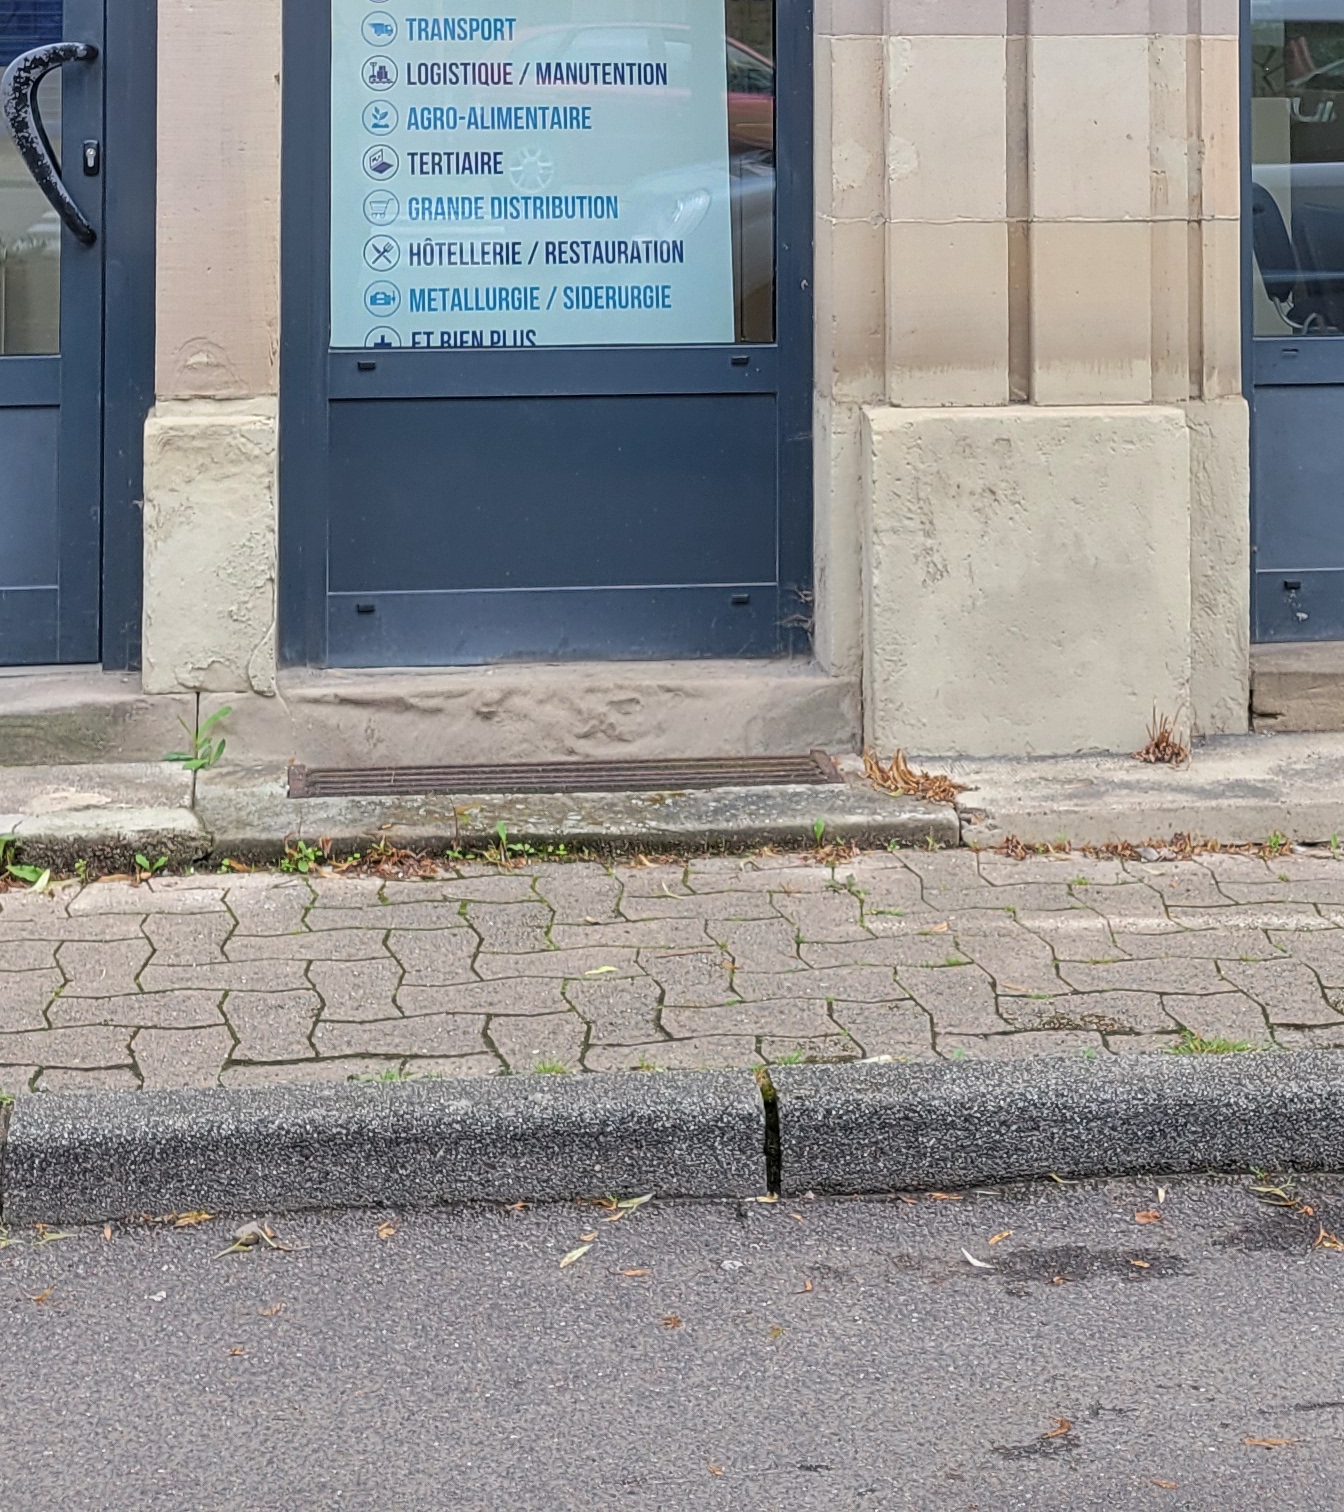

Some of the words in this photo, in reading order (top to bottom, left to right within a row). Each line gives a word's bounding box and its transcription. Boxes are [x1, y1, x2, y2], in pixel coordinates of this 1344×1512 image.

[405, 17, 517, 42] TRANSPORT
[406, 62, 513, 87] LOGISTIQUE
[518, 62, 531, 86] /
[535, 62, 669, 86] MANUTENTION
[406, 106, 593, 131] AGRO-ALIMENTAIRE
[407, 151, 504, 176] TERTIAIRE
[407, 196, 485, 221] GRANDE
[490, 195, 619, 220] DISTRIBUTION
[408, 238, 523, 267] HÔTELLERIE
[527, 240, 540, 266] /
[544, 239, 685, 265] RESTAURATION
[409, 286, 541, 313] METALLURGIE
[545, 286, 558, 311] /
[563, 285, 672, 310] SIDERURGIE
[411, 330, 435, 347] ET
